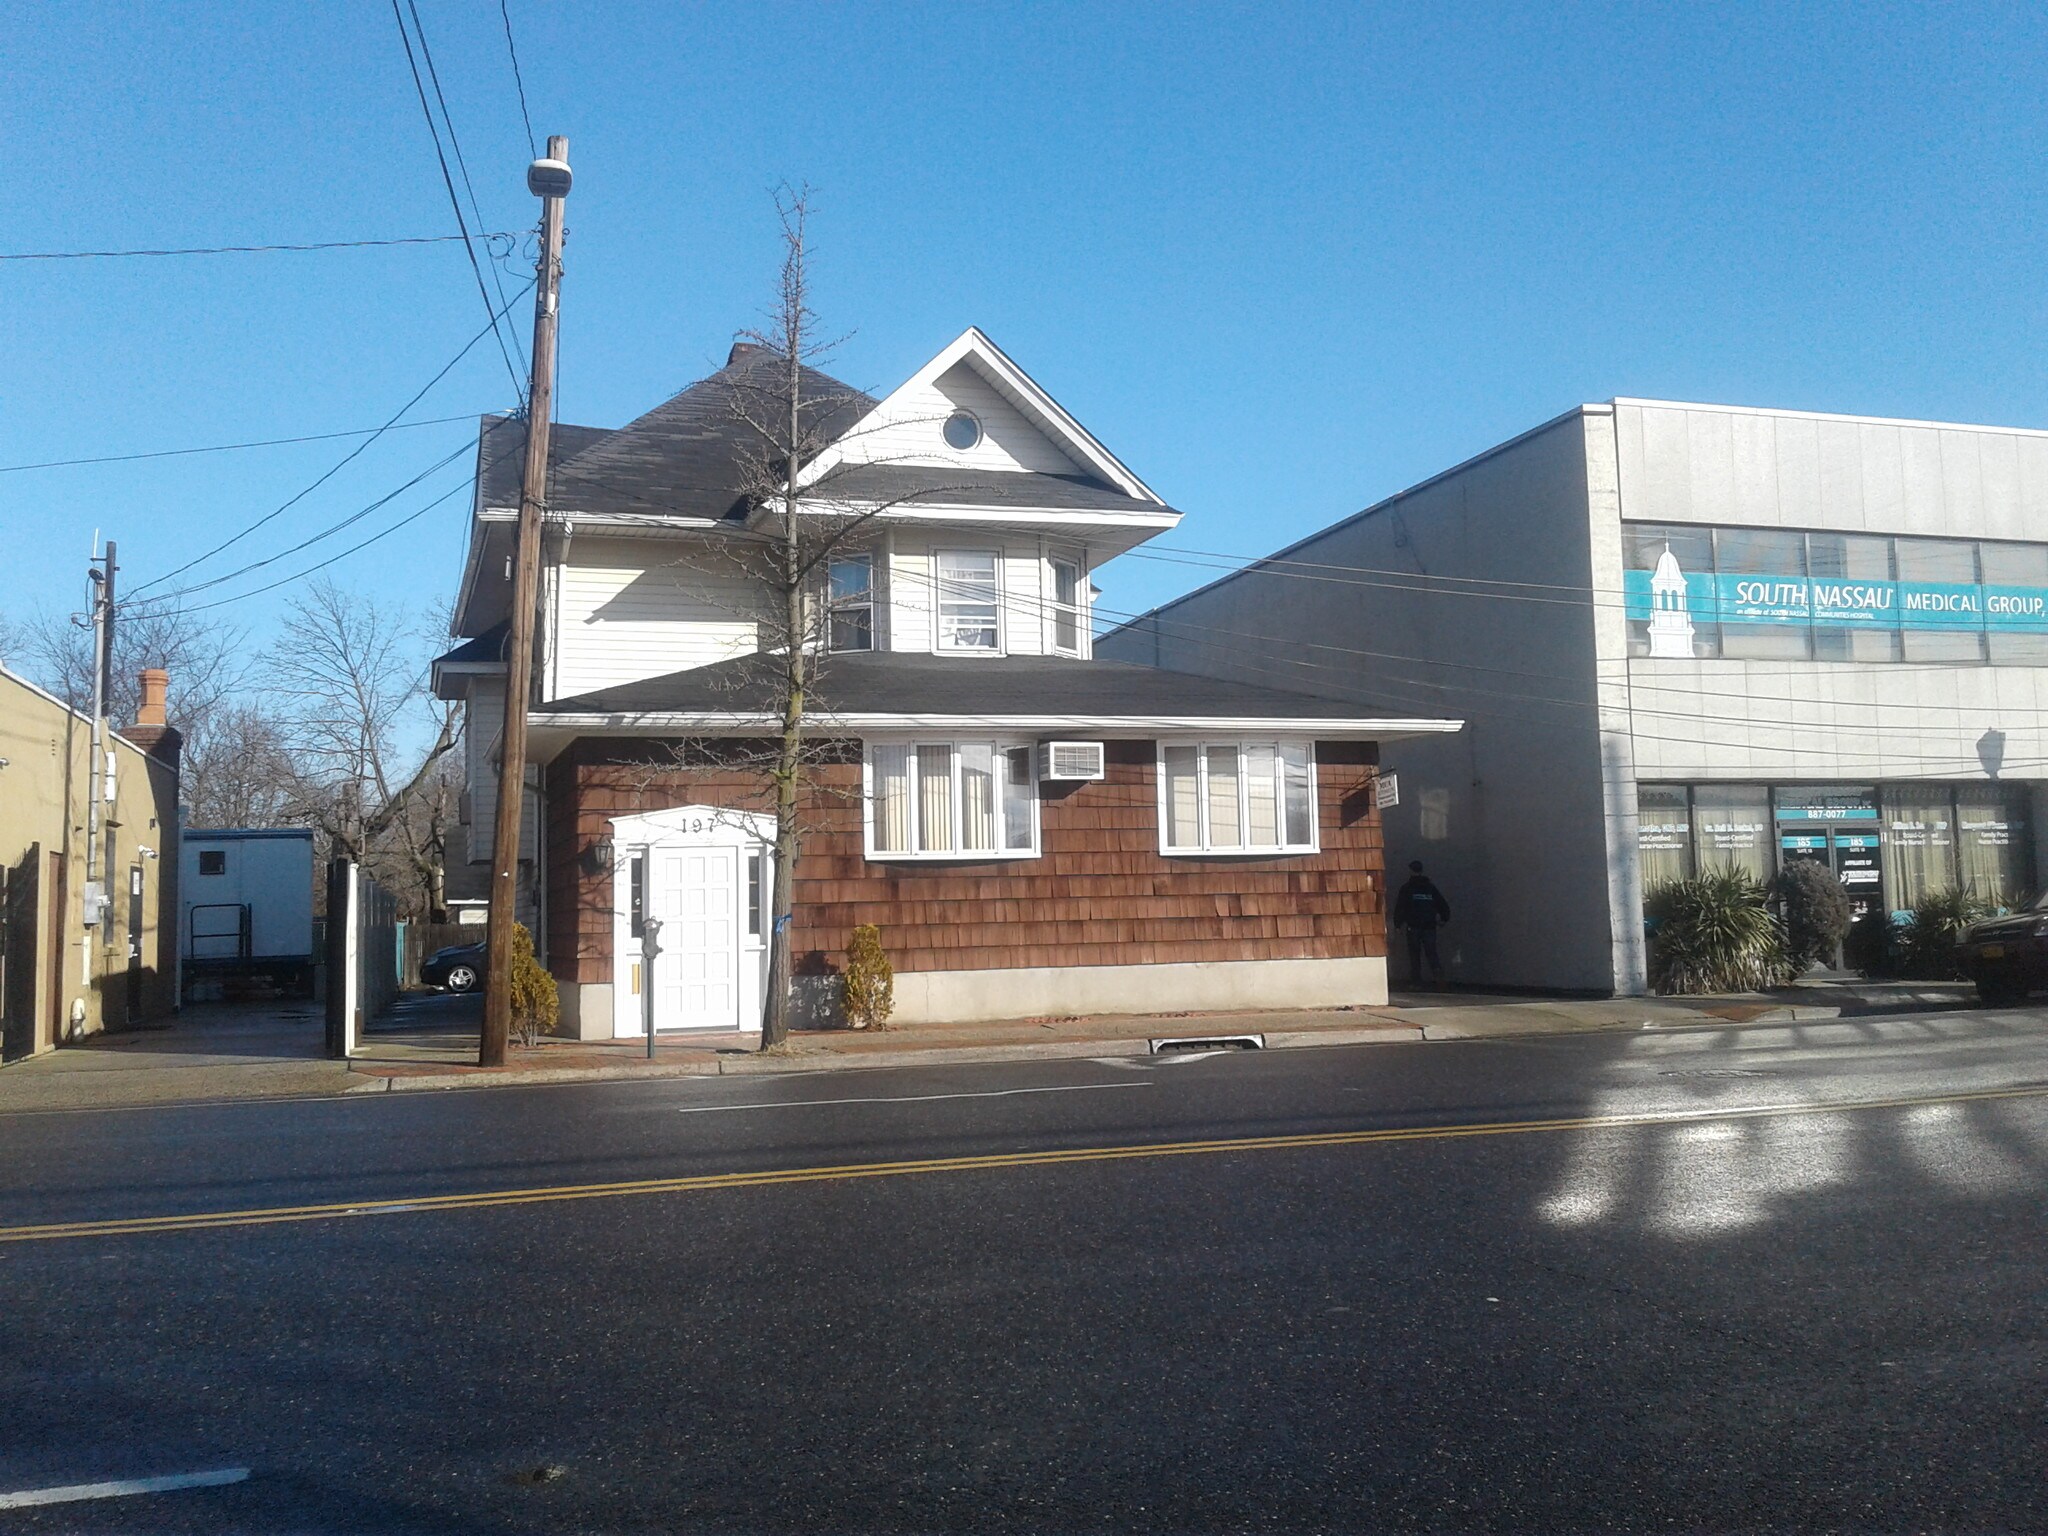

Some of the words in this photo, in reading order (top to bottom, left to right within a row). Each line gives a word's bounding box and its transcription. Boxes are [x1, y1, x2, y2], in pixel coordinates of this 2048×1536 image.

[1735, 581, 1807, 606] SOUTH
[1814, 585, 1893, 609] NASSAU
[1907, 593, 1982, 612] MEDICAL
[1808, 810, 1846, 818] 887-0077
[682, 818, 715, 833] 197
[1796, 838, 1811, 847] 185
[1850, 837, 1864, 846] 185
